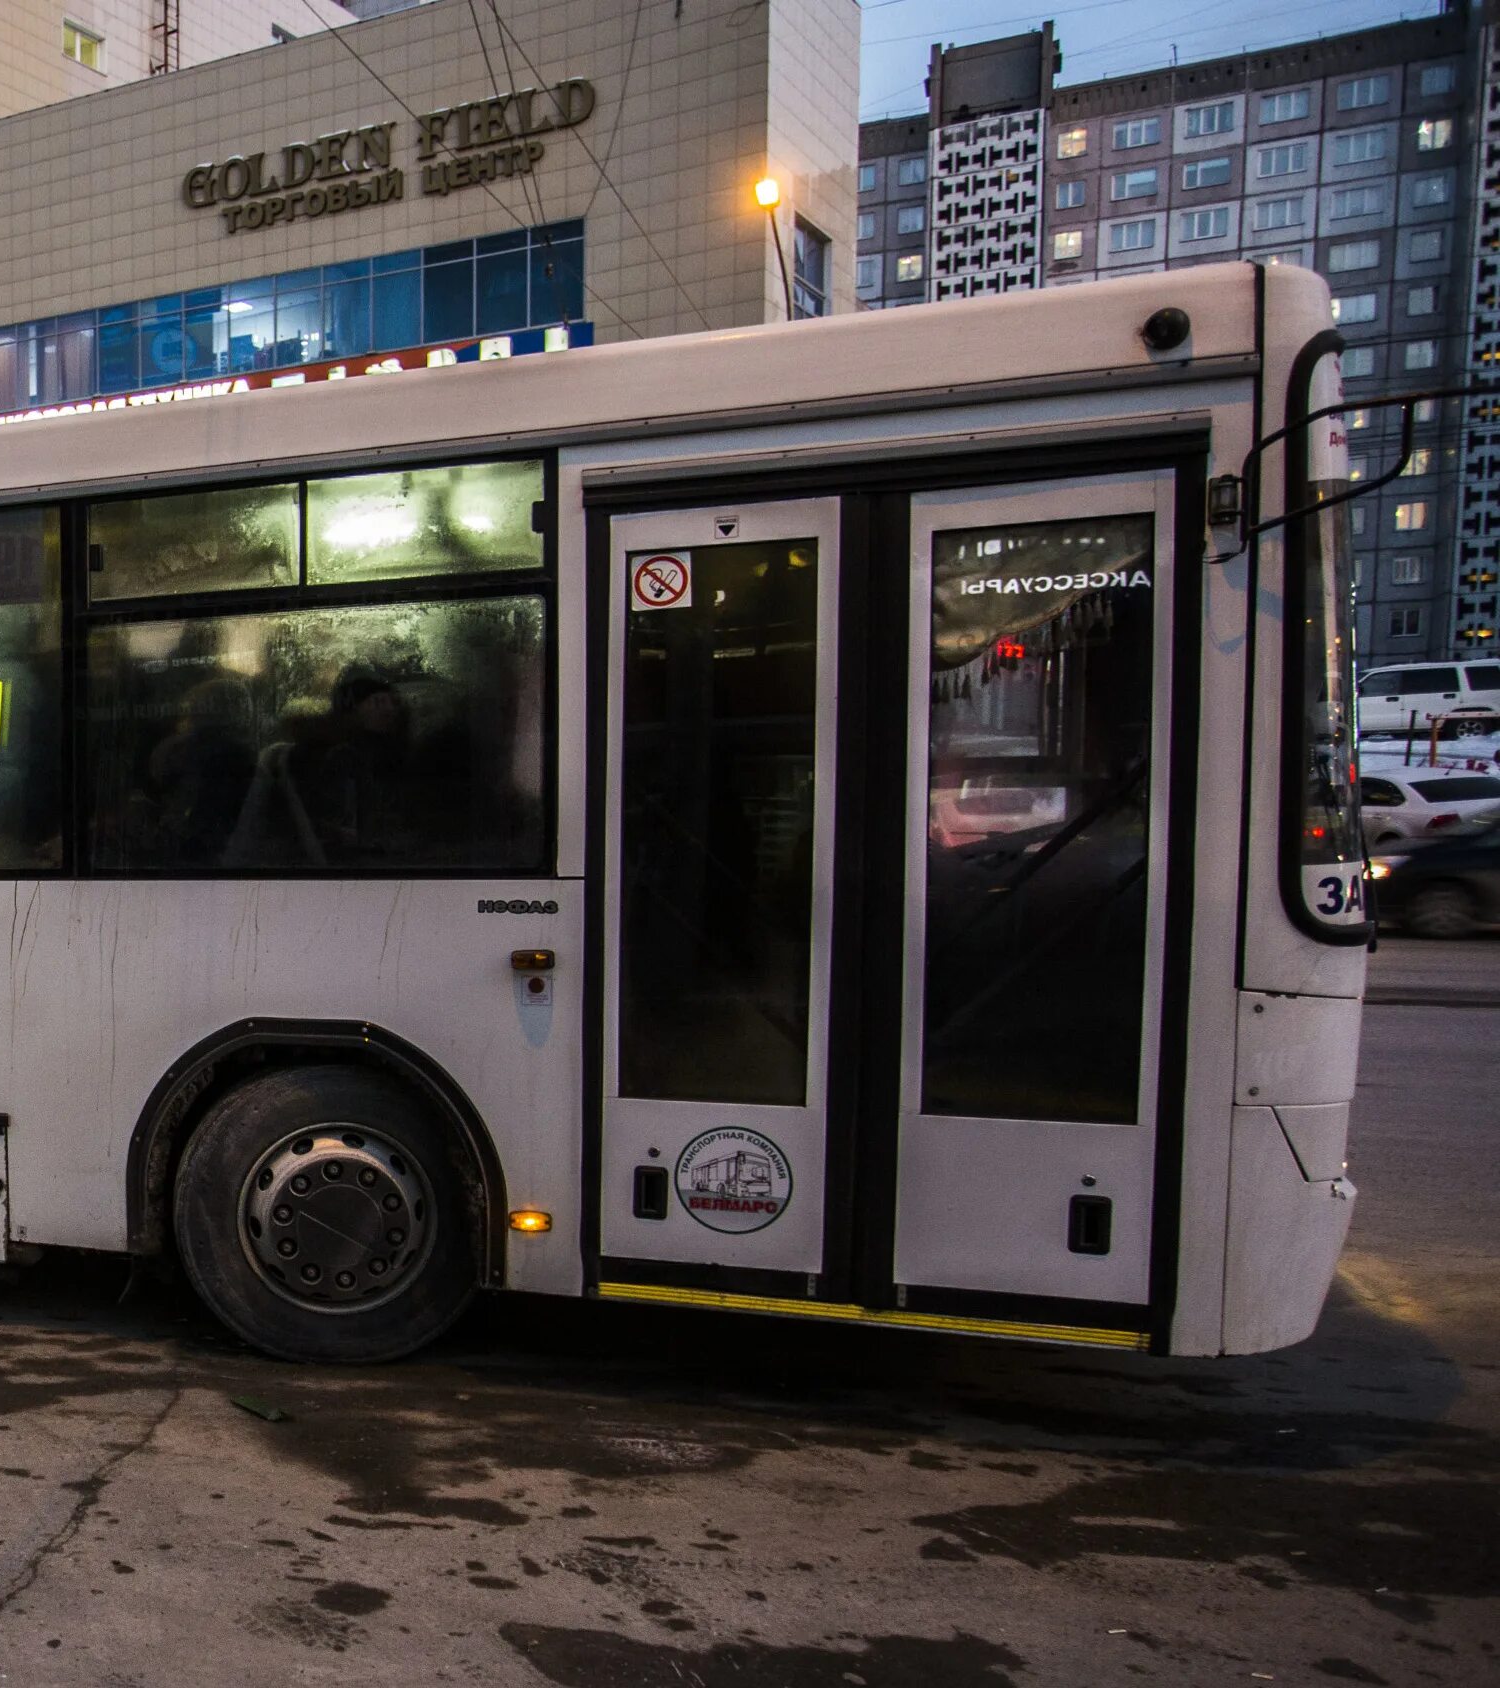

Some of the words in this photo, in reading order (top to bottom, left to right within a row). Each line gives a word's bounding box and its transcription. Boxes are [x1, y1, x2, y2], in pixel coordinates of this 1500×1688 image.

[181, 121, 397, 210] GOLDEN
[416, 77, 597, 162] FIELD
[222, 168, 403, 234] ТОРГОВЫЙ
[422, 140, 545, 196] ЦЕНТР
[680, 1131, 746, 1175] ТРАНСПОРТНАЯ
[746, 1135, 787, 1180] КОМПАНИЯ
